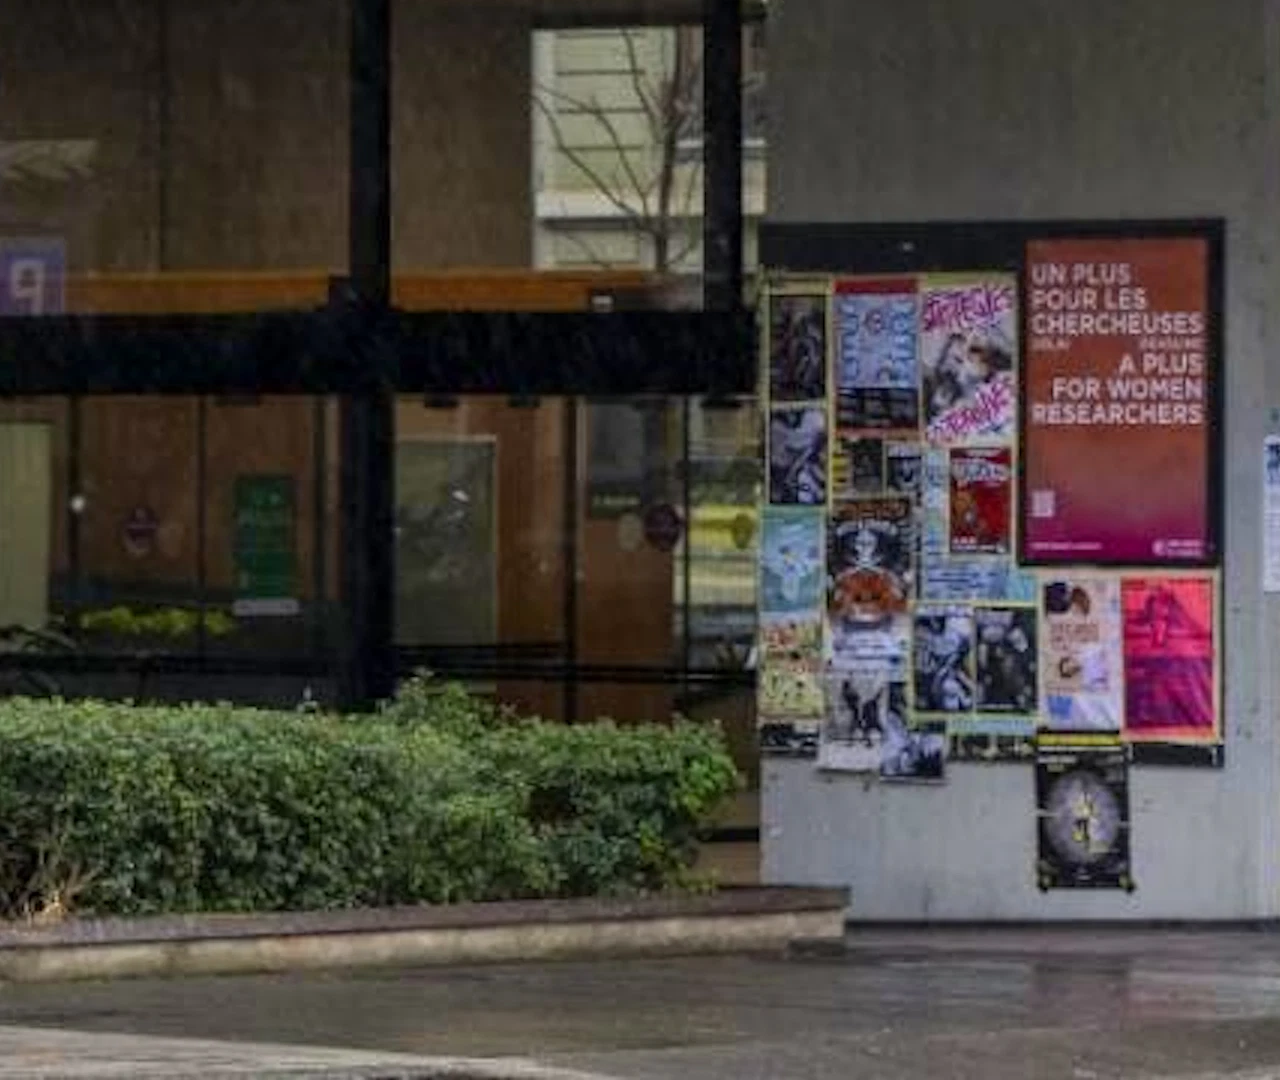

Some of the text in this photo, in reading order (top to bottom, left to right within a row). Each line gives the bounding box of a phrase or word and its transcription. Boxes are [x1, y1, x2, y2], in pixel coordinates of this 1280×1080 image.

[1031, 263, 1131, 285] UN PLUS
[1032, 287, 1098, 310] POUR
[1103, 287, 1148, 310] LES
[1031, 312, 1206, 335] CHERCHEUSES
[1119, 353, 1205, 375] A PLUS
[1052, 377, 1204, 400] FOR WOMEN
[1031, 402, 1205, 425] RESEARCHERS
